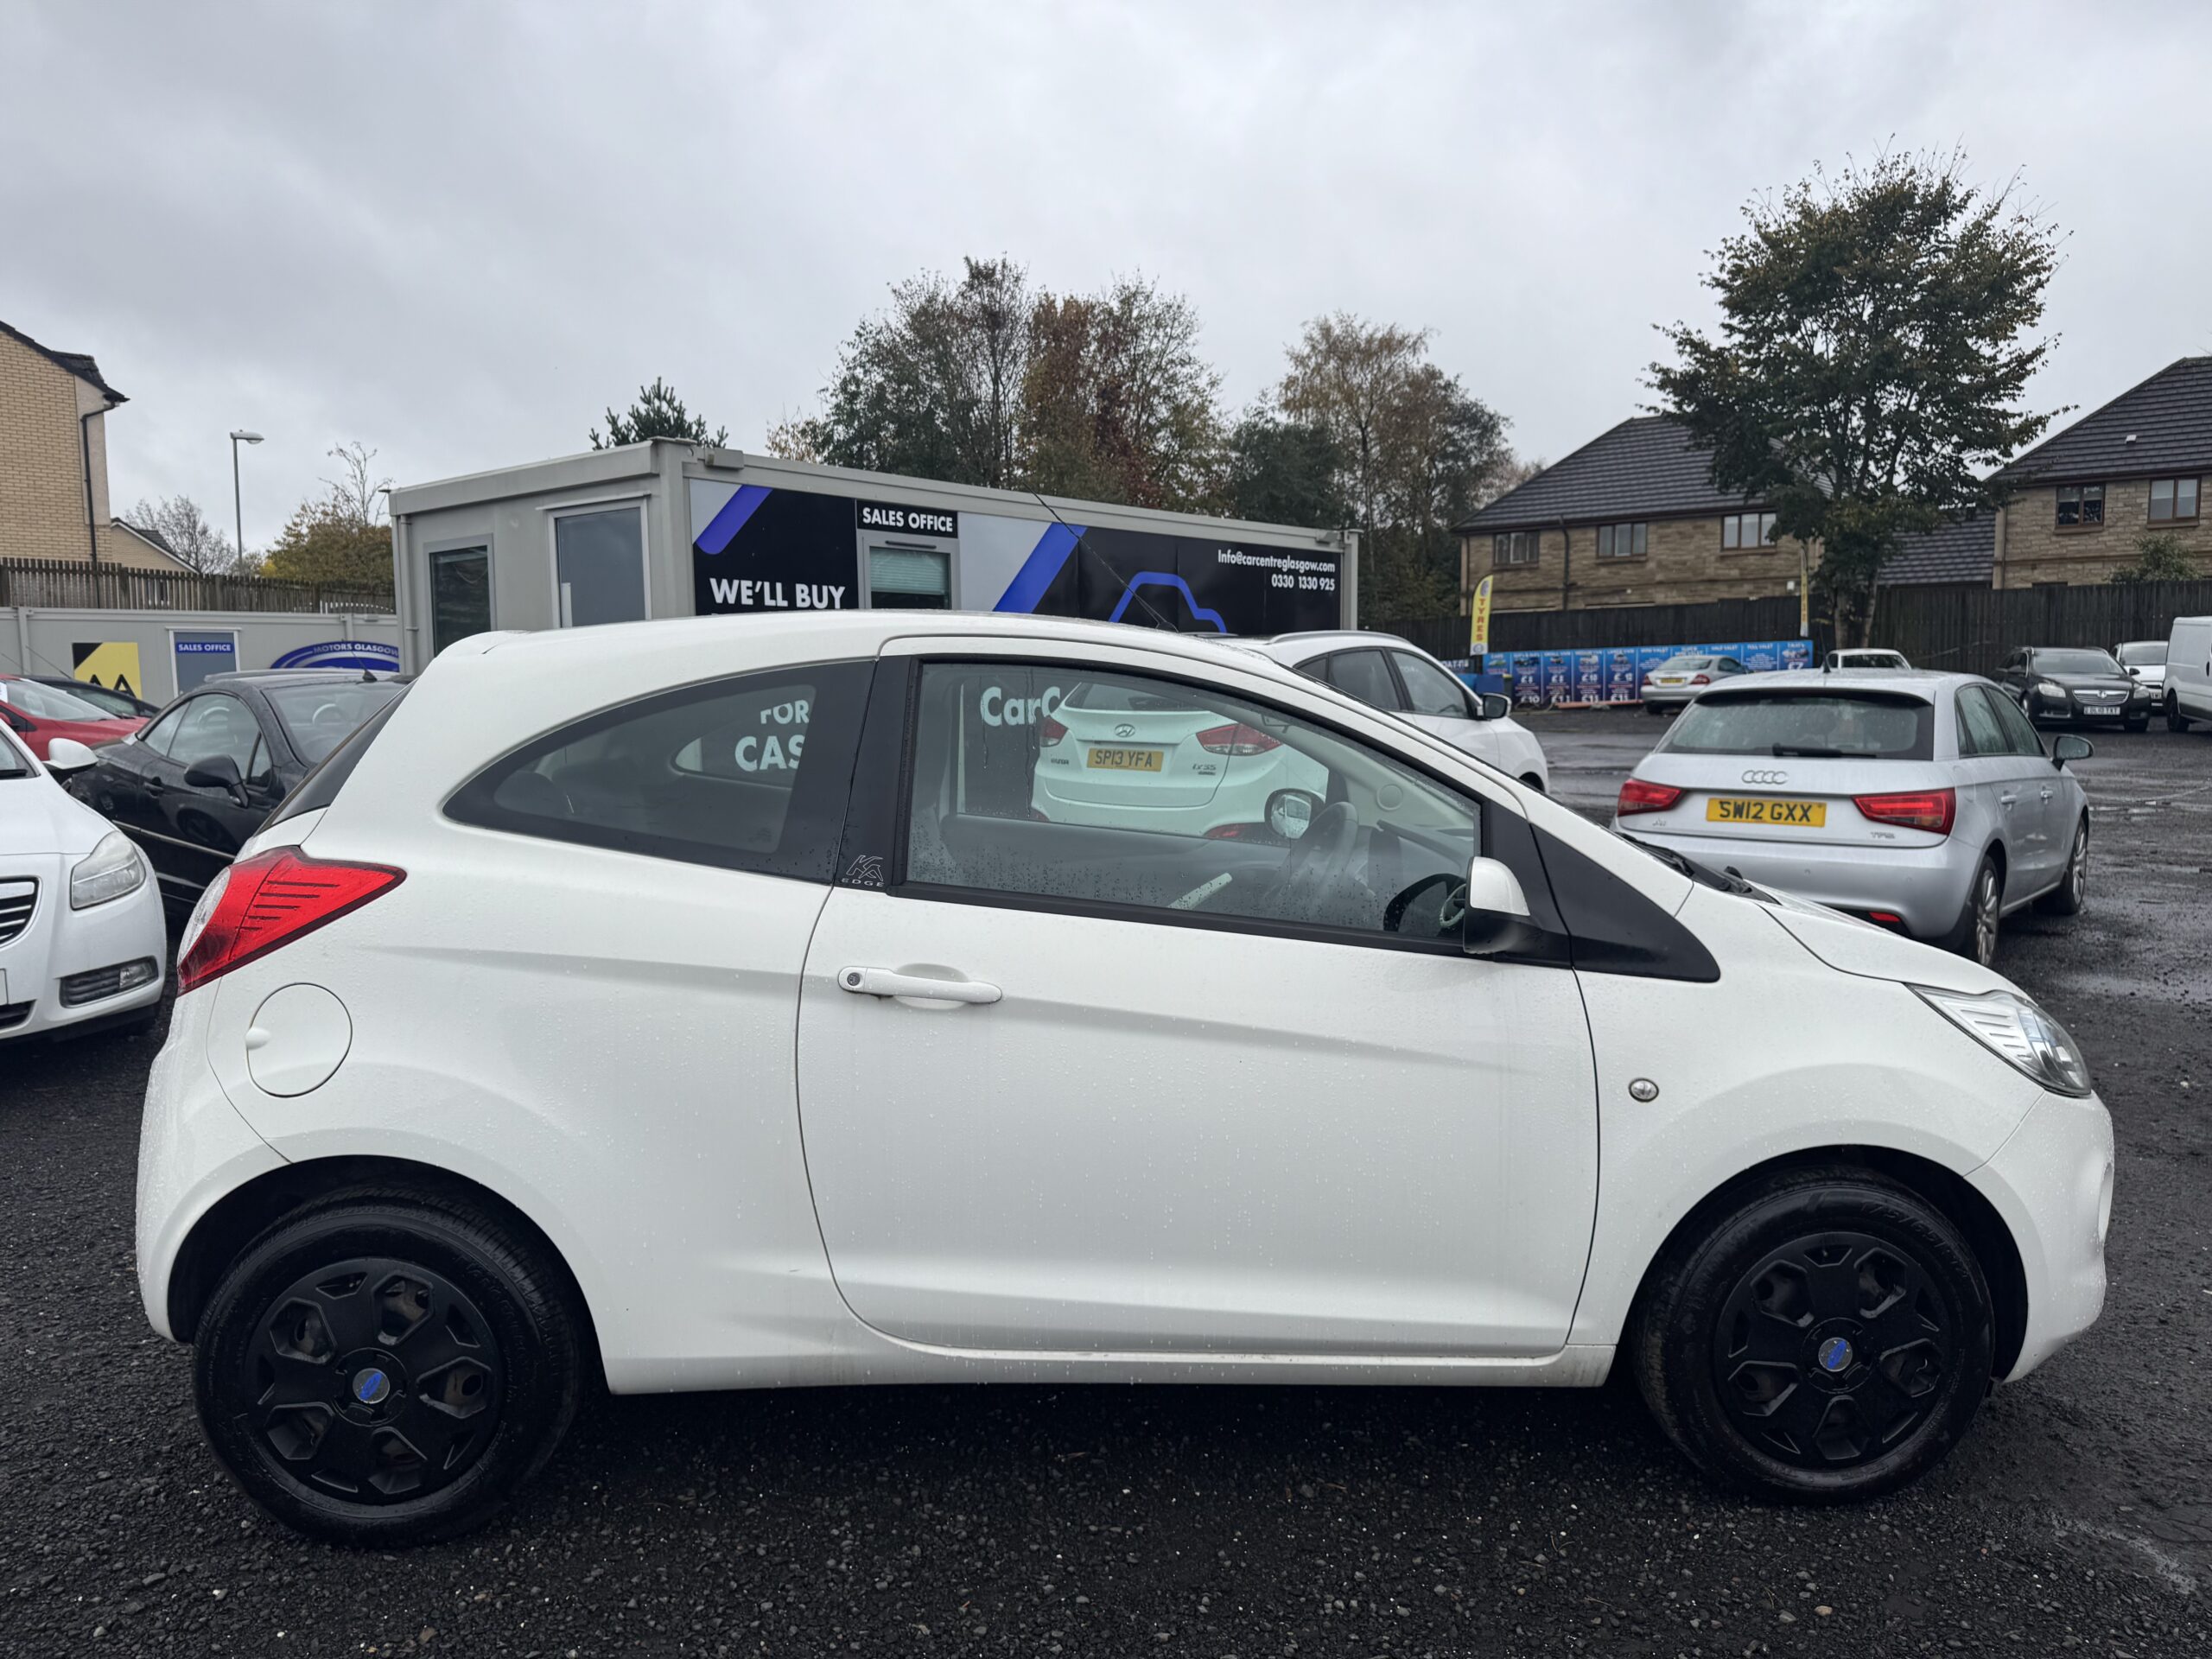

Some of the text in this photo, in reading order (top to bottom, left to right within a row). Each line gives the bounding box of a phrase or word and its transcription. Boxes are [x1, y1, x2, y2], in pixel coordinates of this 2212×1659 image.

[862, 507, 953, 532] SALES OFFICE
[1218, 549, 1335, 573] Info@carcentreglasgow.com
[709, 577, 845, 609] WE'LL BUY
[1271, 574, 1335, 591] 0330 1330 925
[1476, 598, 1486, 641] TYRES
[314, 643, 398, 657] MOTORS GLASGOW
[1095, 750, 1153, 767] SP13 YFA
[1719, 800, 1812, 823] SW12 GXX
[841, 877, 885, 887] EDGE
